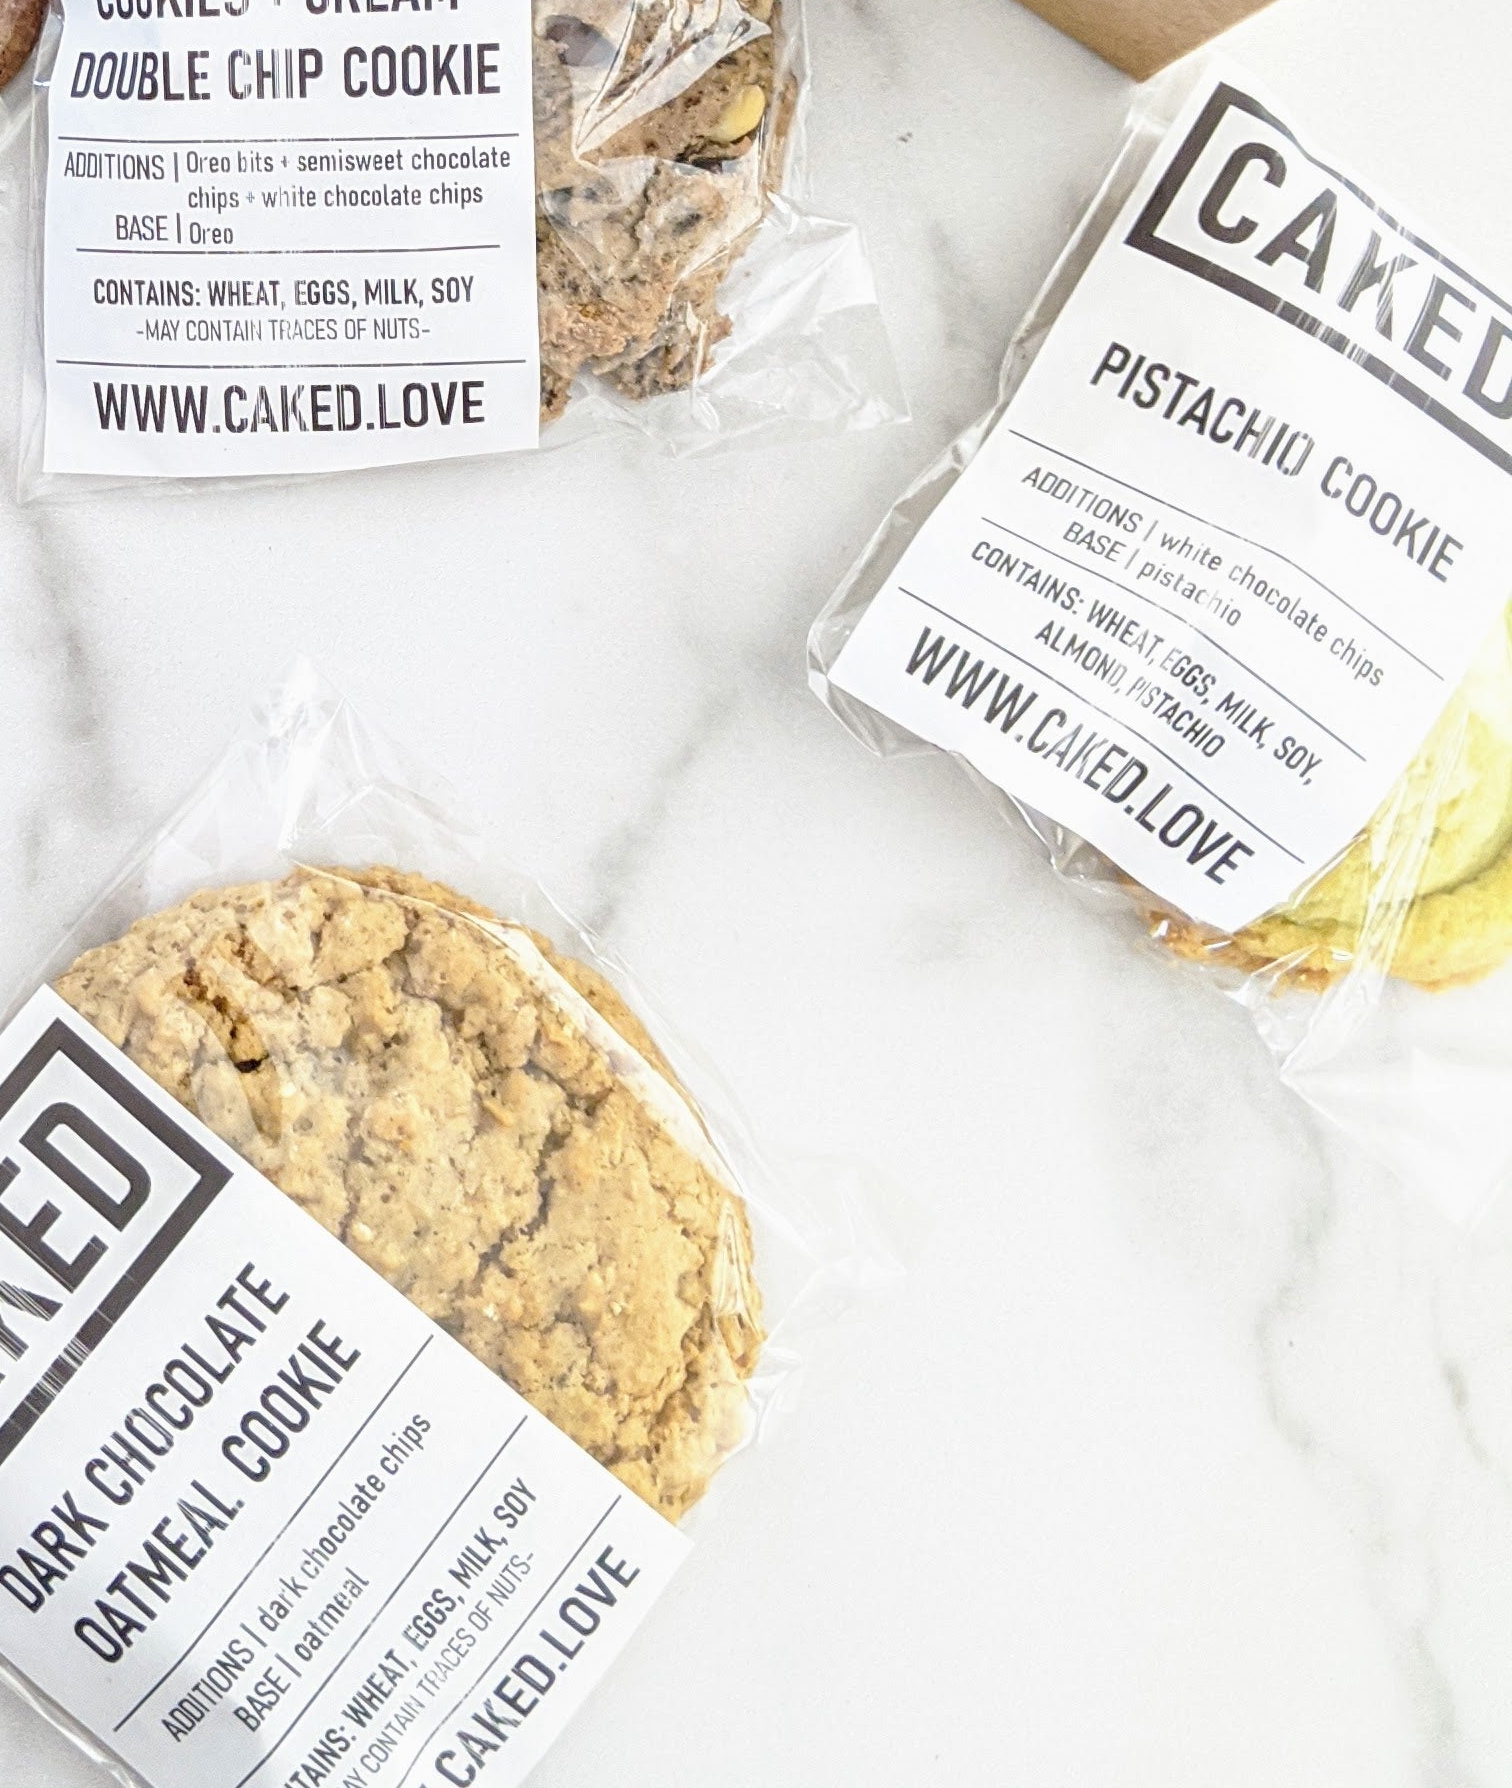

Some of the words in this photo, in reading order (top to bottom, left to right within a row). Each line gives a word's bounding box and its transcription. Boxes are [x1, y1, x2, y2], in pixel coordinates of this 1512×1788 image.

[70, 50, 210, 101] DOUBLE
[228, 48, 323, 100] CHIP
[343, 42, 500, 98] COOKIE
[64, 151, 164, 180] ADDITIONS
[186, 150, 230, 173] Oreo
[237, 150, 274, 172] bits
[296, 148, 403, 172] semisweet
[411, 145, 510, 170] chocolate
[115, 214, 168, 241] BASE
[190, 222, 233, 244] Oreo
[188, 186, 239, 214] chips
[261, 185, 316, 208] white
[324, 184, 421, 206] chocolate
[430, 181, 483, 209] chips
[94, 278, 200, 306] CONTAINS:
[207, 280, 285, 310] WHEAT,
[294, 279, 356, 310] EGGS,
[364, 278, 423, 308] MILK,
[431, 276, 474, 303] SOY
[136, 319, 179, 341] -MAY
[186, 319, 262, 341] CONTAIN
[268, 318, 337, 340] TRACES
[374, 317, 430, 339] NUTS-
[1198, 142, 1512, 419] CAKED
[93, 380, 484, 433] WWW.CAKED.LOVE
[1089, 341, 1315, 476] PISTACHIO
[1320, 456, 1464, 583] COOKIE
[1021, 466, 1143, 533] ADDITIONS
[1160, 532, 1222, 570] white
[1228, 565, 1327, 642] chocolate
[1330, 637, 1383, 686] chips
[1062, 521, 1126, 562] BASE
[971, 541, 1084, 614] CONTAINS:
[1086, 599, 1164, 666] WHEAT,
[1159, 648, 1216, 705] EGGS,
[1214, 690, 1275, 749] MILK,
[1273, 736, 1322, 785] SOY,
[1034, 620, 1127, 693] ALMOND,
[1125, 676, 1225, 757] PISTACHIO
[905, 625, 1255, 885] WWW.CAKED.LOVE
[84, 1261, 290, 1505] CHOCOLATE
[73, 1479, 244, 1663] OATMEAL
[221, 1318, 361, 1482] COOKIE
[161, 1638, 254, 1742] ADDITIONS
[257, 1576, 308, 1632] dark
[300, 1474, 385, 1579] chocolate
[380, 1414, 431, 1475] chips
[232, 1666, 291, 1732] BASE
[294, 1566, 369, 1661] oatmeal
[340, 1648, 418, 1728] WHEAT,
[401, 1588, 465, 1651] EGGS,
[447, 1526, 508, 1589] MILK,
[493, 1477, 536, 1529] SOY
